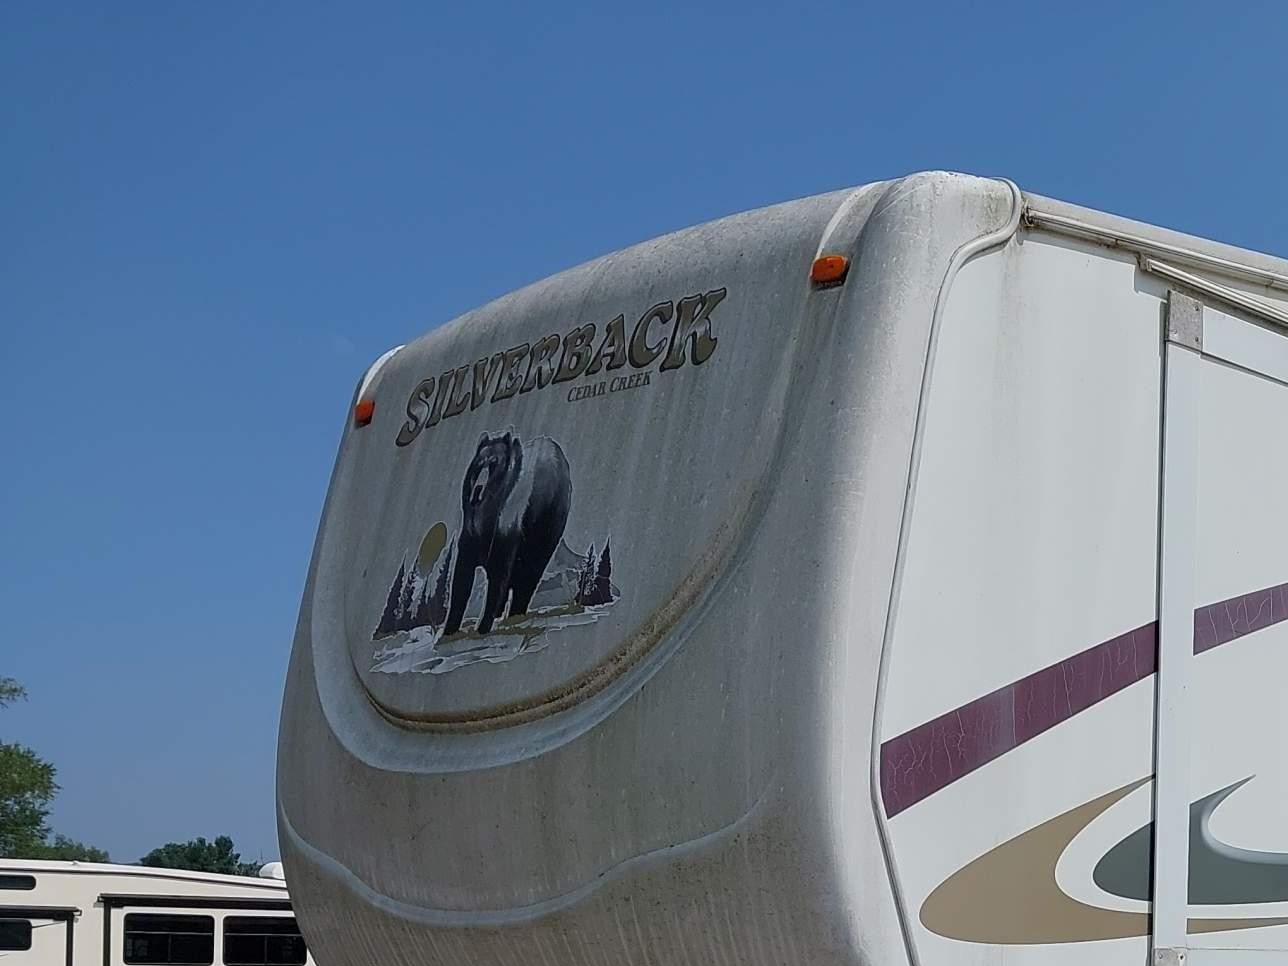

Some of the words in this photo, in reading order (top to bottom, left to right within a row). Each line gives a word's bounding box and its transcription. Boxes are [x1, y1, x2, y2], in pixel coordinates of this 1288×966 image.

[395, 287, 727, 448] SILVERBACK
[566, 381, 607, 403] CEDAR
[609, 371, 651, 395] CREEK
